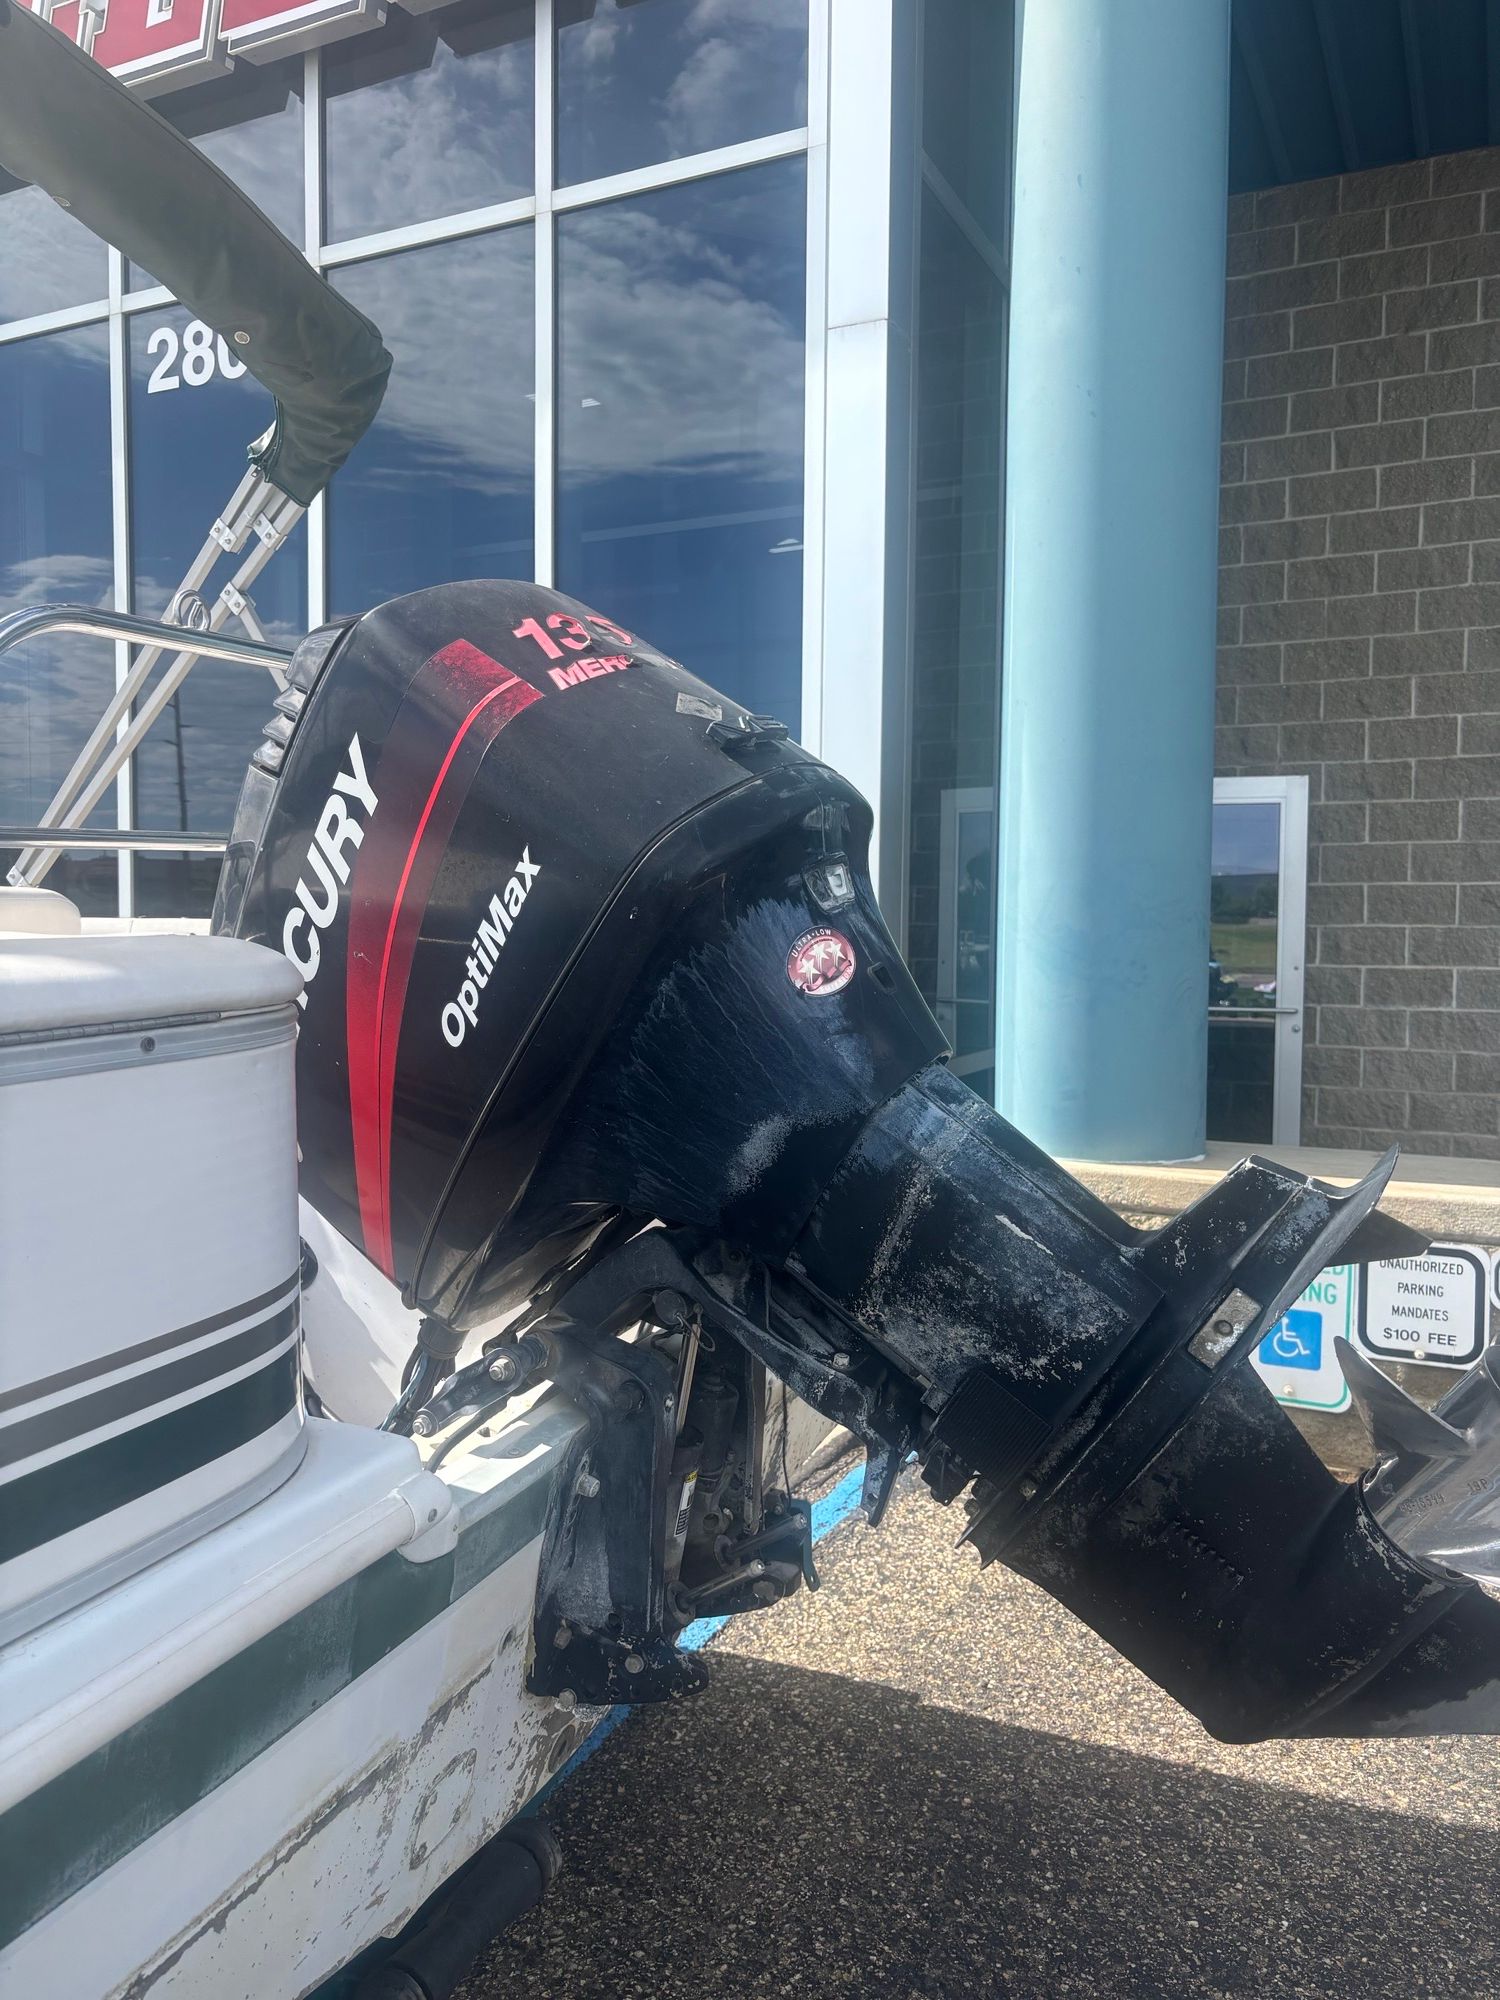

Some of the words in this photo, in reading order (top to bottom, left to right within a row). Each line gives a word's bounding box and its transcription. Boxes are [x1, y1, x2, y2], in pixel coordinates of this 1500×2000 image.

[282, 731, 378, 1012] CURY
[441, 845, 541, 1048] OptiMax
[1379, 1257, 1464, 1276] UNAUTHORIZED
[1397, 1281, 1444, 1298] PARKING
[1391, 1304, 1449, 1322] MANDATES
[1383, 1327, 1420, 1342] $100
[1428, 1332, 1457, 1347] FEE
